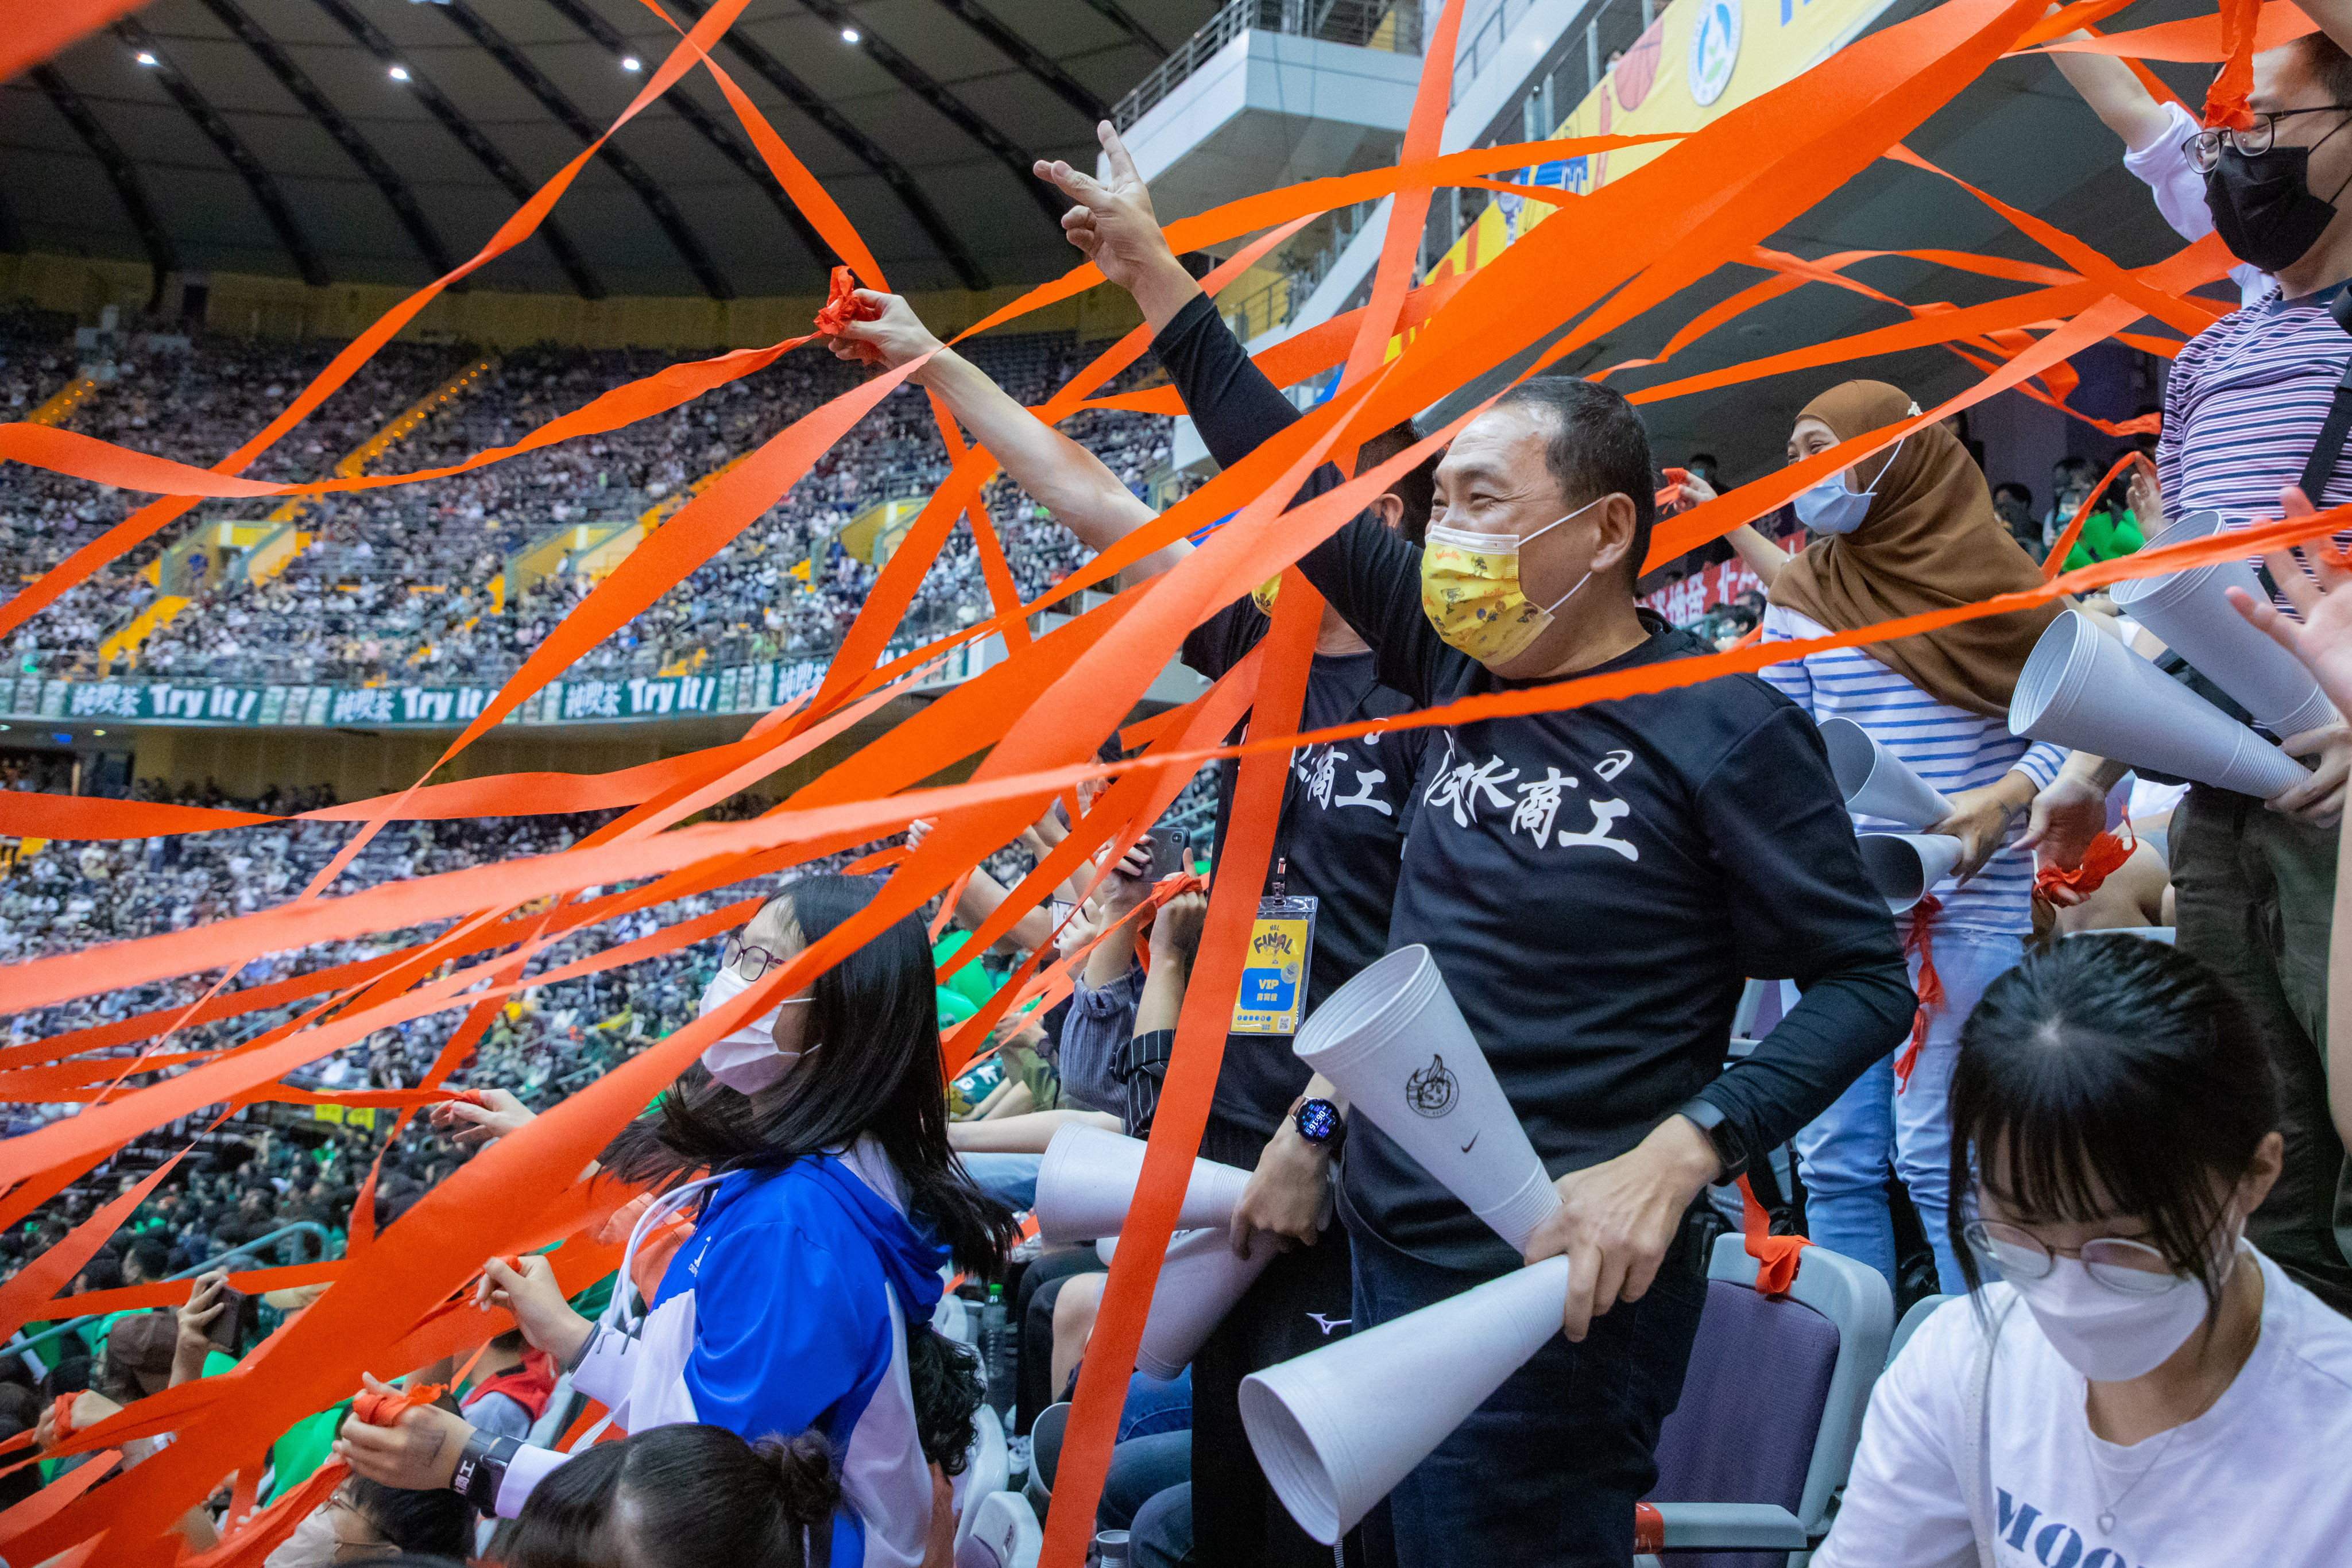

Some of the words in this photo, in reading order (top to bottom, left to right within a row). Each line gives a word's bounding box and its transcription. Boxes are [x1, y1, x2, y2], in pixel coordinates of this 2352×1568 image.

[149, 683, 206, 718] Try
[209, 686, 258, 721] it!
[401, 686, 454, 722] Try
[628, 676, 676, 714] Try
[678, 675, 716, 712] it!
[1254, 932, 1293, 954] FINAL
[1259, 979, 1279, 989] VIP
[1309, 1110, 1326, 1130] 06:16
